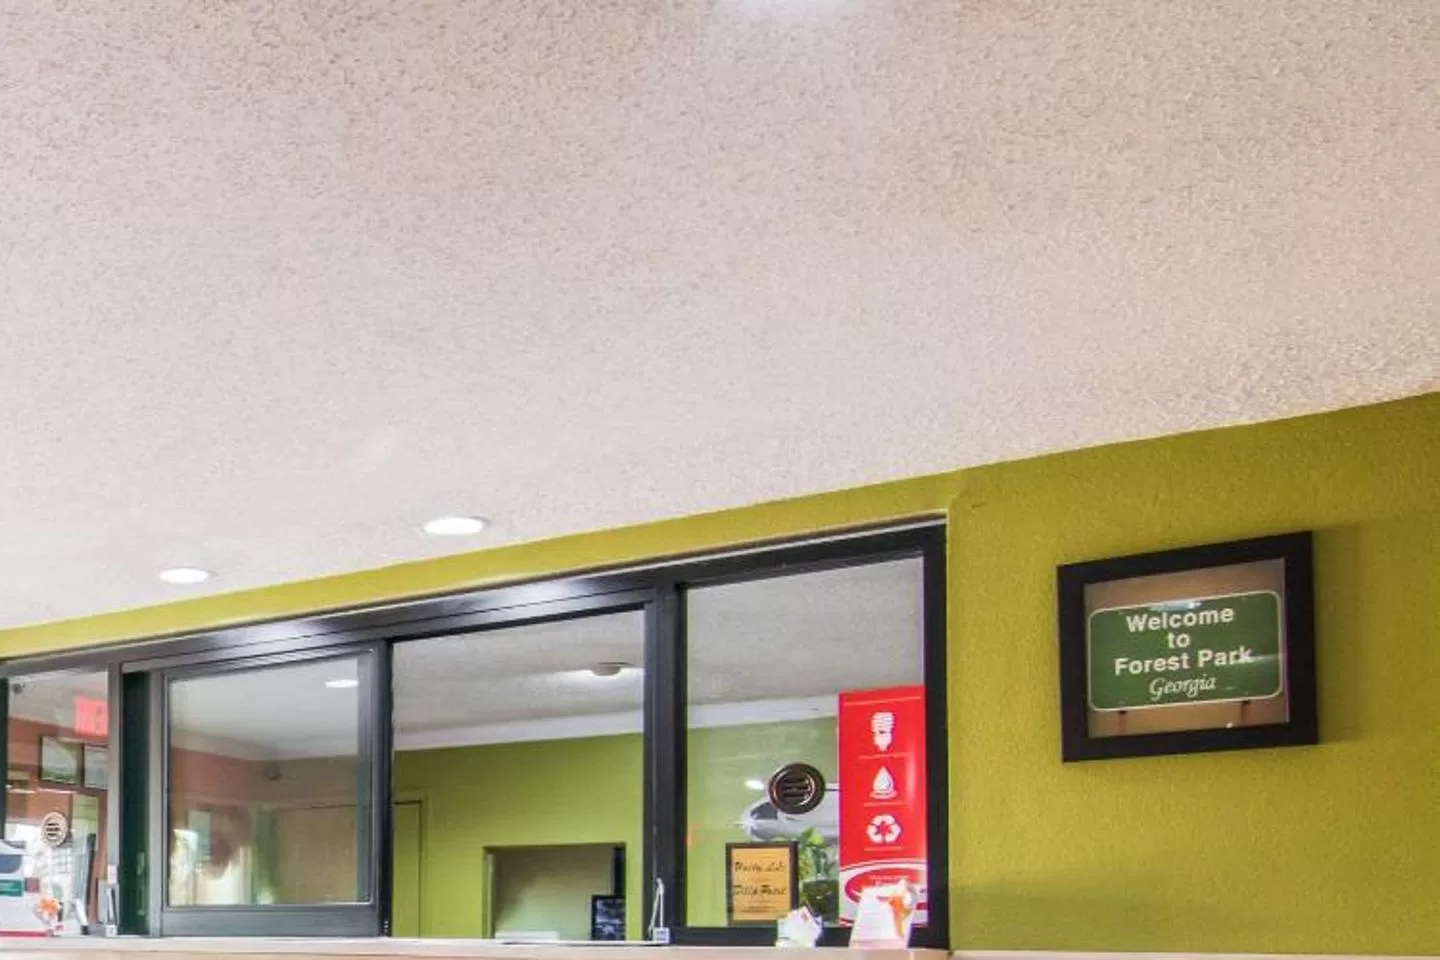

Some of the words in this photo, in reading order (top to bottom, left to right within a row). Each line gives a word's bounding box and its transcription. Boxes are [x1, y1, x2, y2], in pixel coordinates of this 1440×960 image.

[1126, 607, 1235, 633] Welcome
[1167, 632, 1191, 649] to
[1114, 652, 1192, 676] Forest
[1197, 645, 1255, 668] Park
[1148, 673, 1217, 701] Georgia
